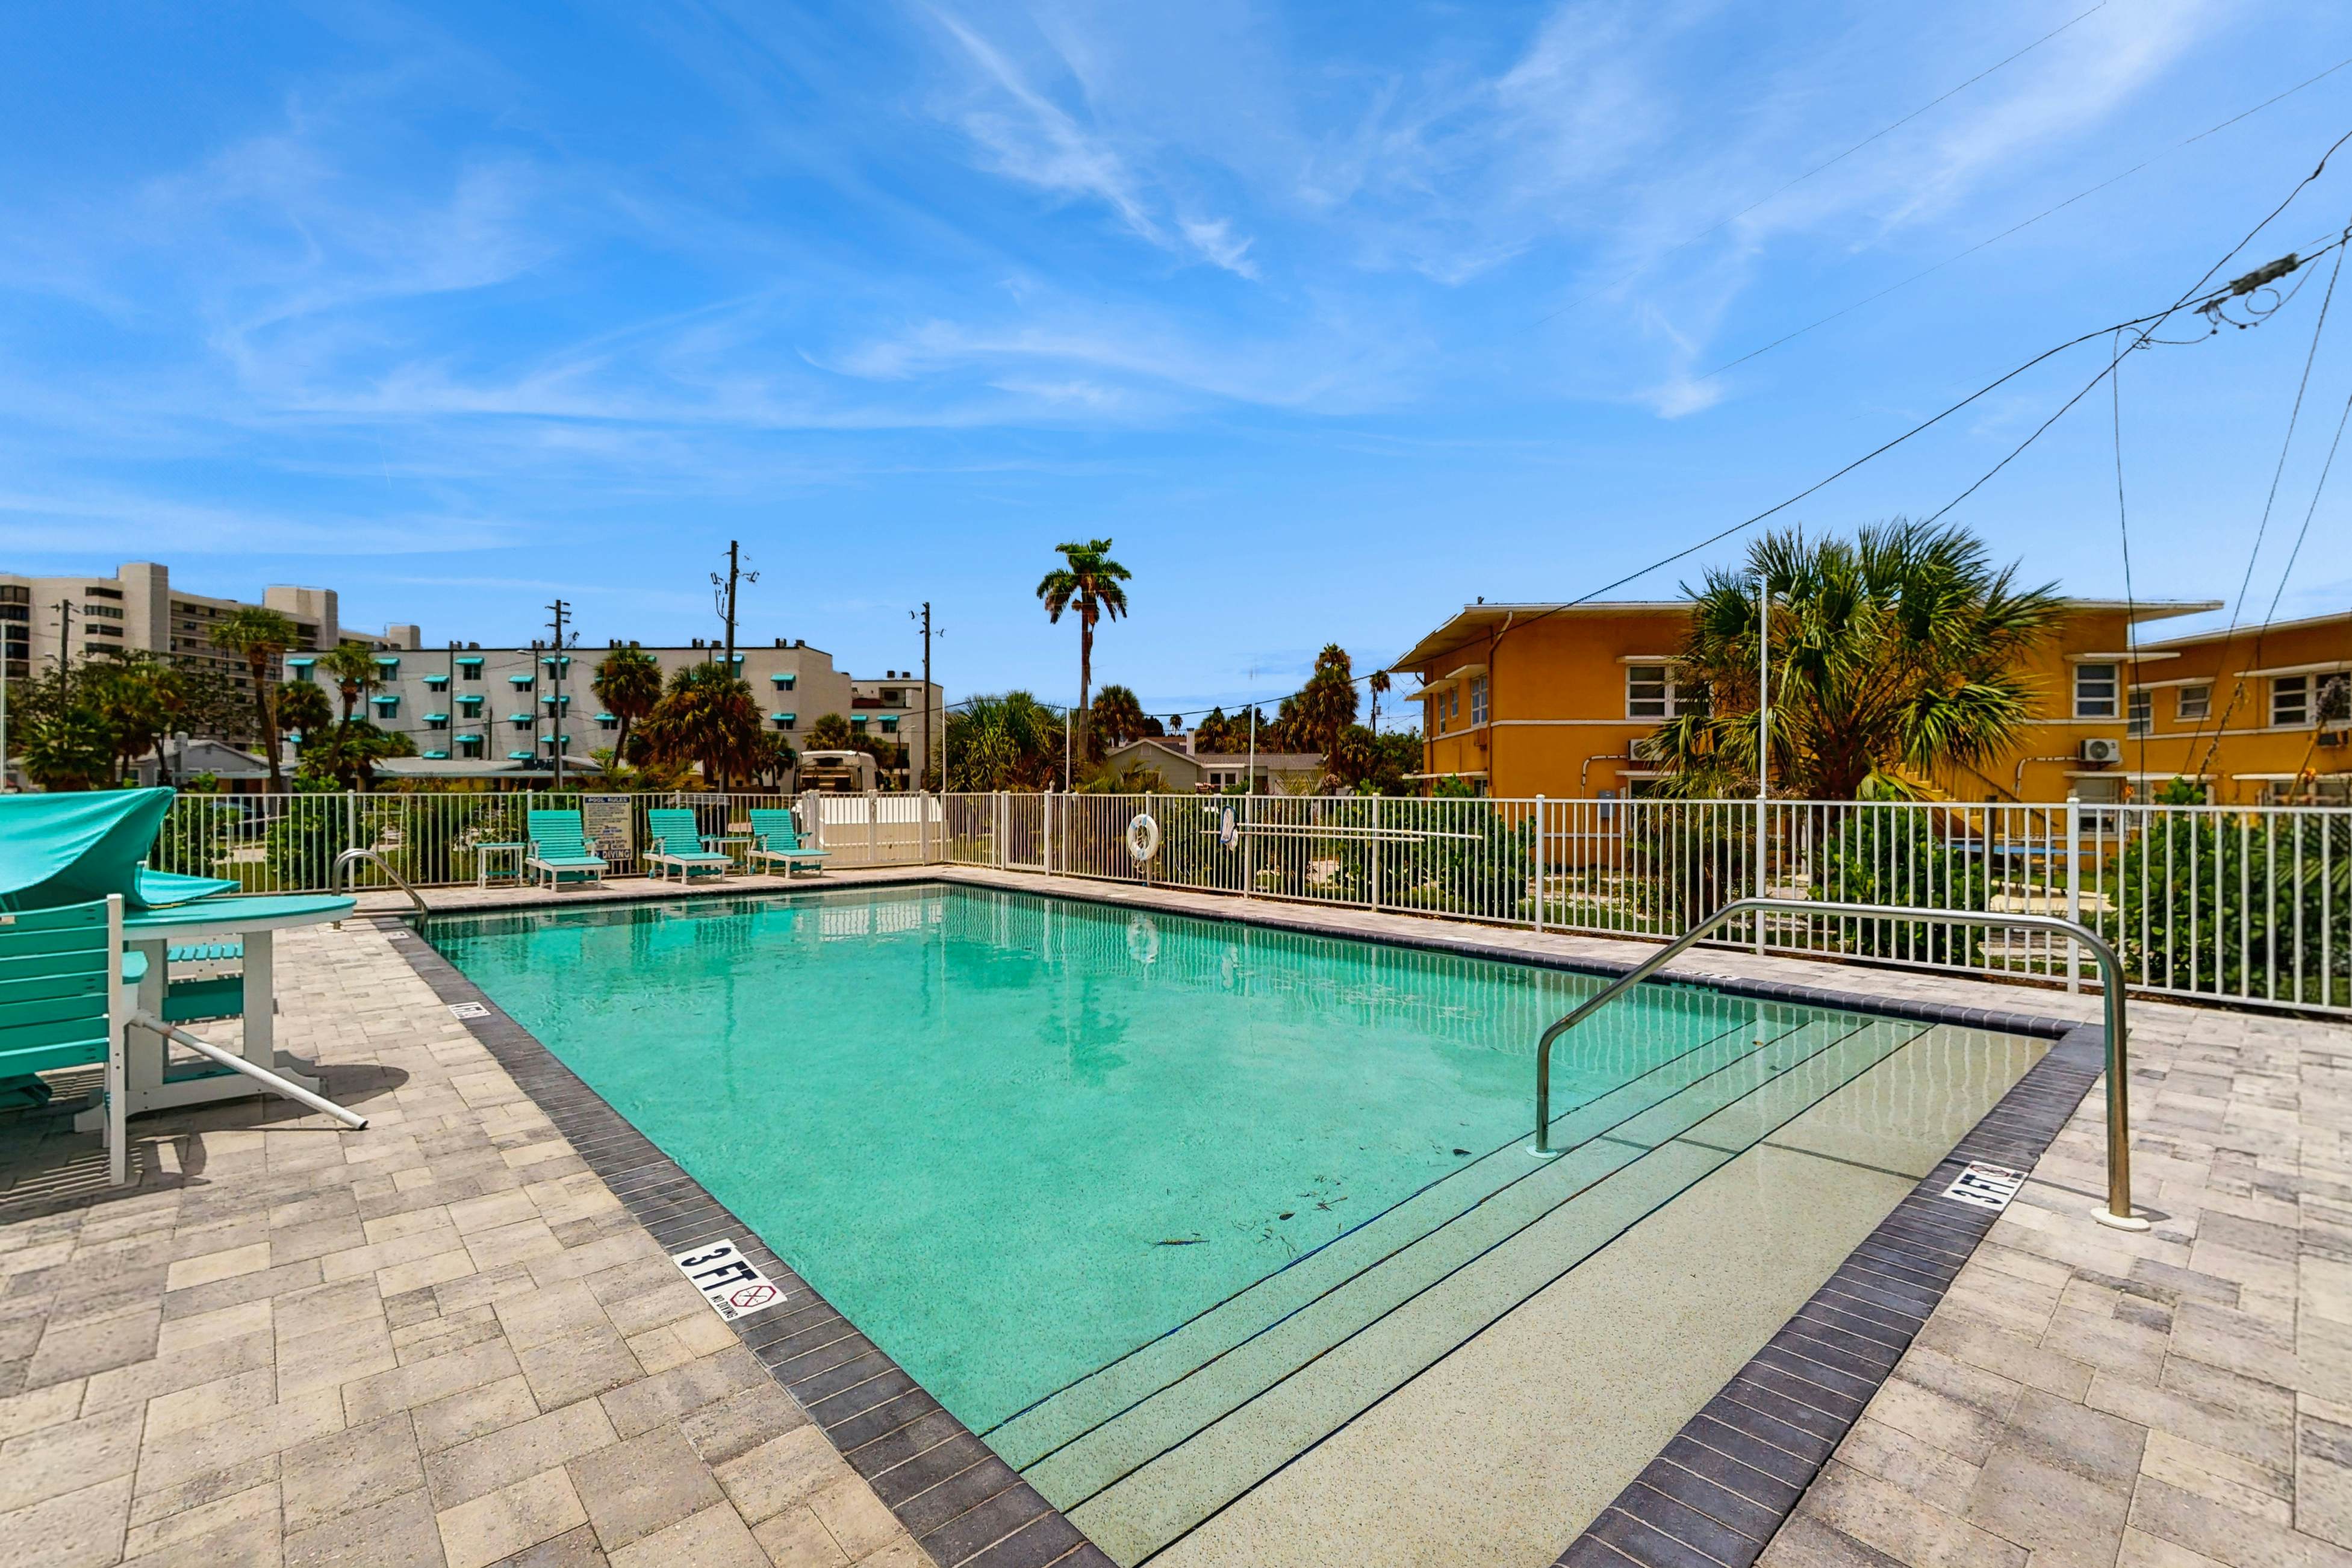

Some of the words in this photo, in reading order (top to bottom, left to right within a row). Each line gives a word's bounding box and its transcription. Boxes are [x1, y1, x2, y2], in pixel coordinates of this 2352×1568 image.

[603, 850, 630, 859] DIVING
[1958, 1174, 2015, 1196] FT
[1951, 1189, 2003, 1204] 3
[680, 1247, 732, 1267] 3
[692, 1260, 759, 1292] FT
[711, 1294, 725, 1303] NO
[717, 1301, 739, 1319] DIVING
